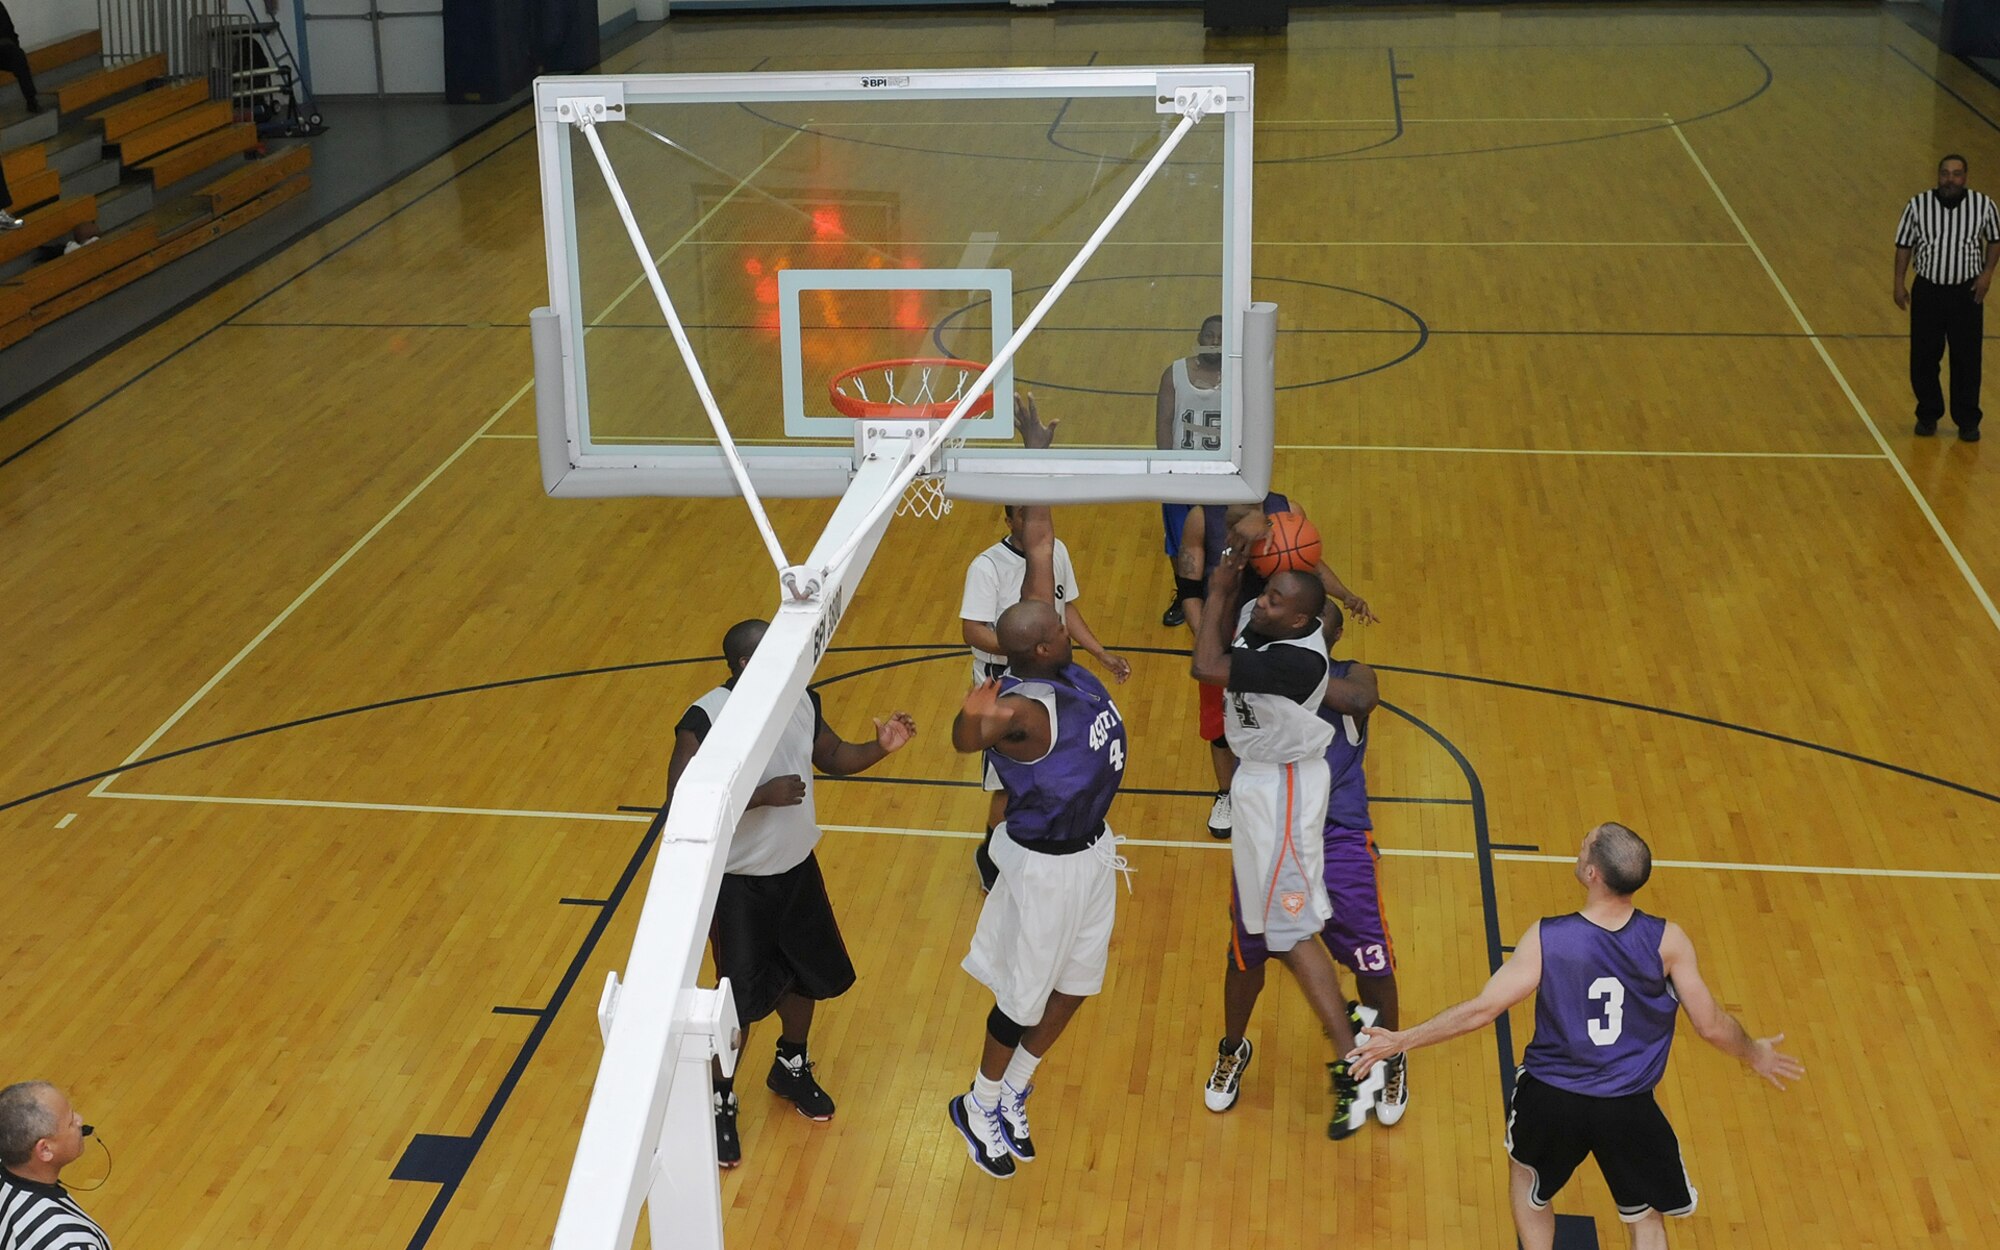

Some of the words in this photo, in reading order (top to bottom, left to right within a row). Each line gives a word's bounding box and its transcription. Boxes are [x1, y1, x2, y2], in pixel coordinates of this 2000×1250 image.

[870, 79, 887, 87] BPI
[1181, 409, 1221, 451] 15
[1109, 738, 1124, 772] 4
[1354, 944, 1386, 971] 13
[1587, 976, 1625, 1046] 3
